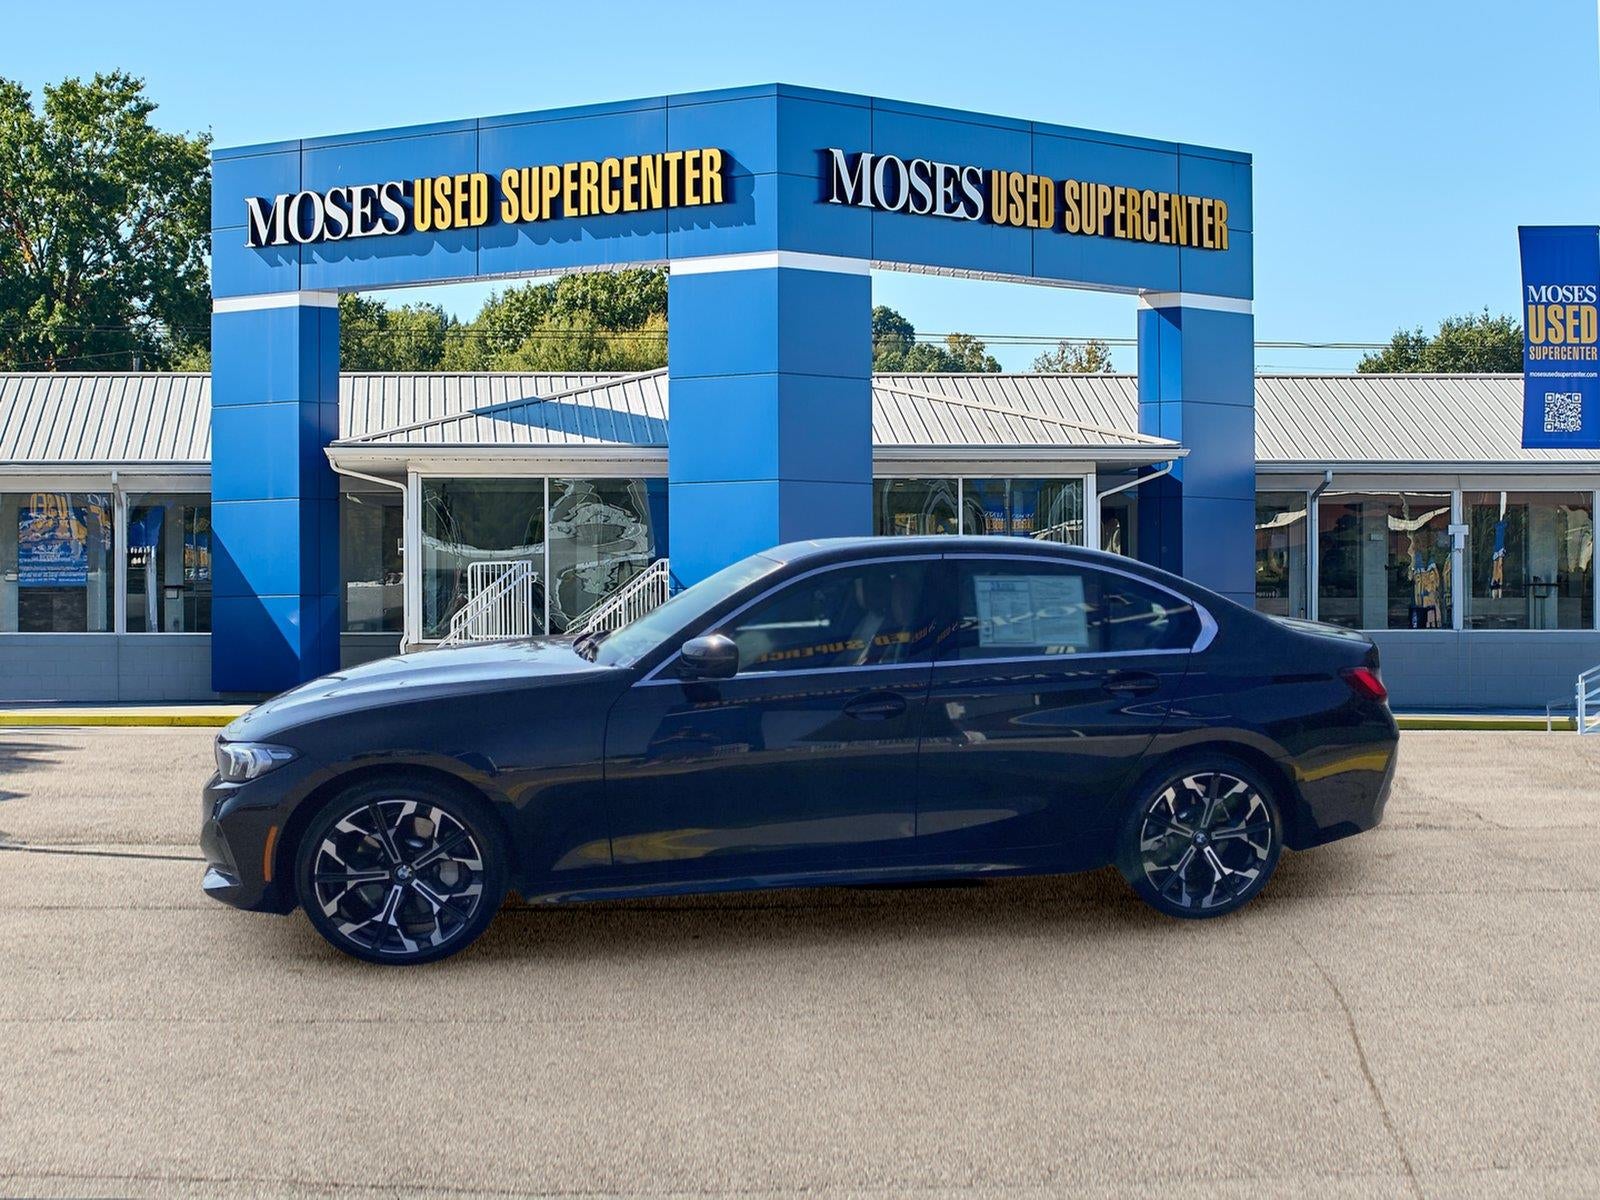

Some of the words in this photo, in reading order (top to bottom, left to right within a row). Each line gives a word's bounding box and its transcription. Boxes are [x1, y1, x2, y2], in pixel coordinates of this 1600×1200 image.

[244, 181, 407, 248] MOSES
[413, 172, 489, 233] USED
[500, 148, 723, 224] SUPERCENTER
[828, 148, 984, 221] MOSES
[991, 169, 1056, 230] USED
[1064, 178, 1230, 251] SUPERCENTER
[1528, 285, 1597, 303] MOSES
[1528, 304, 1597, 344] USED
[1529, 346, 1597, 361] SUPERCENTER
